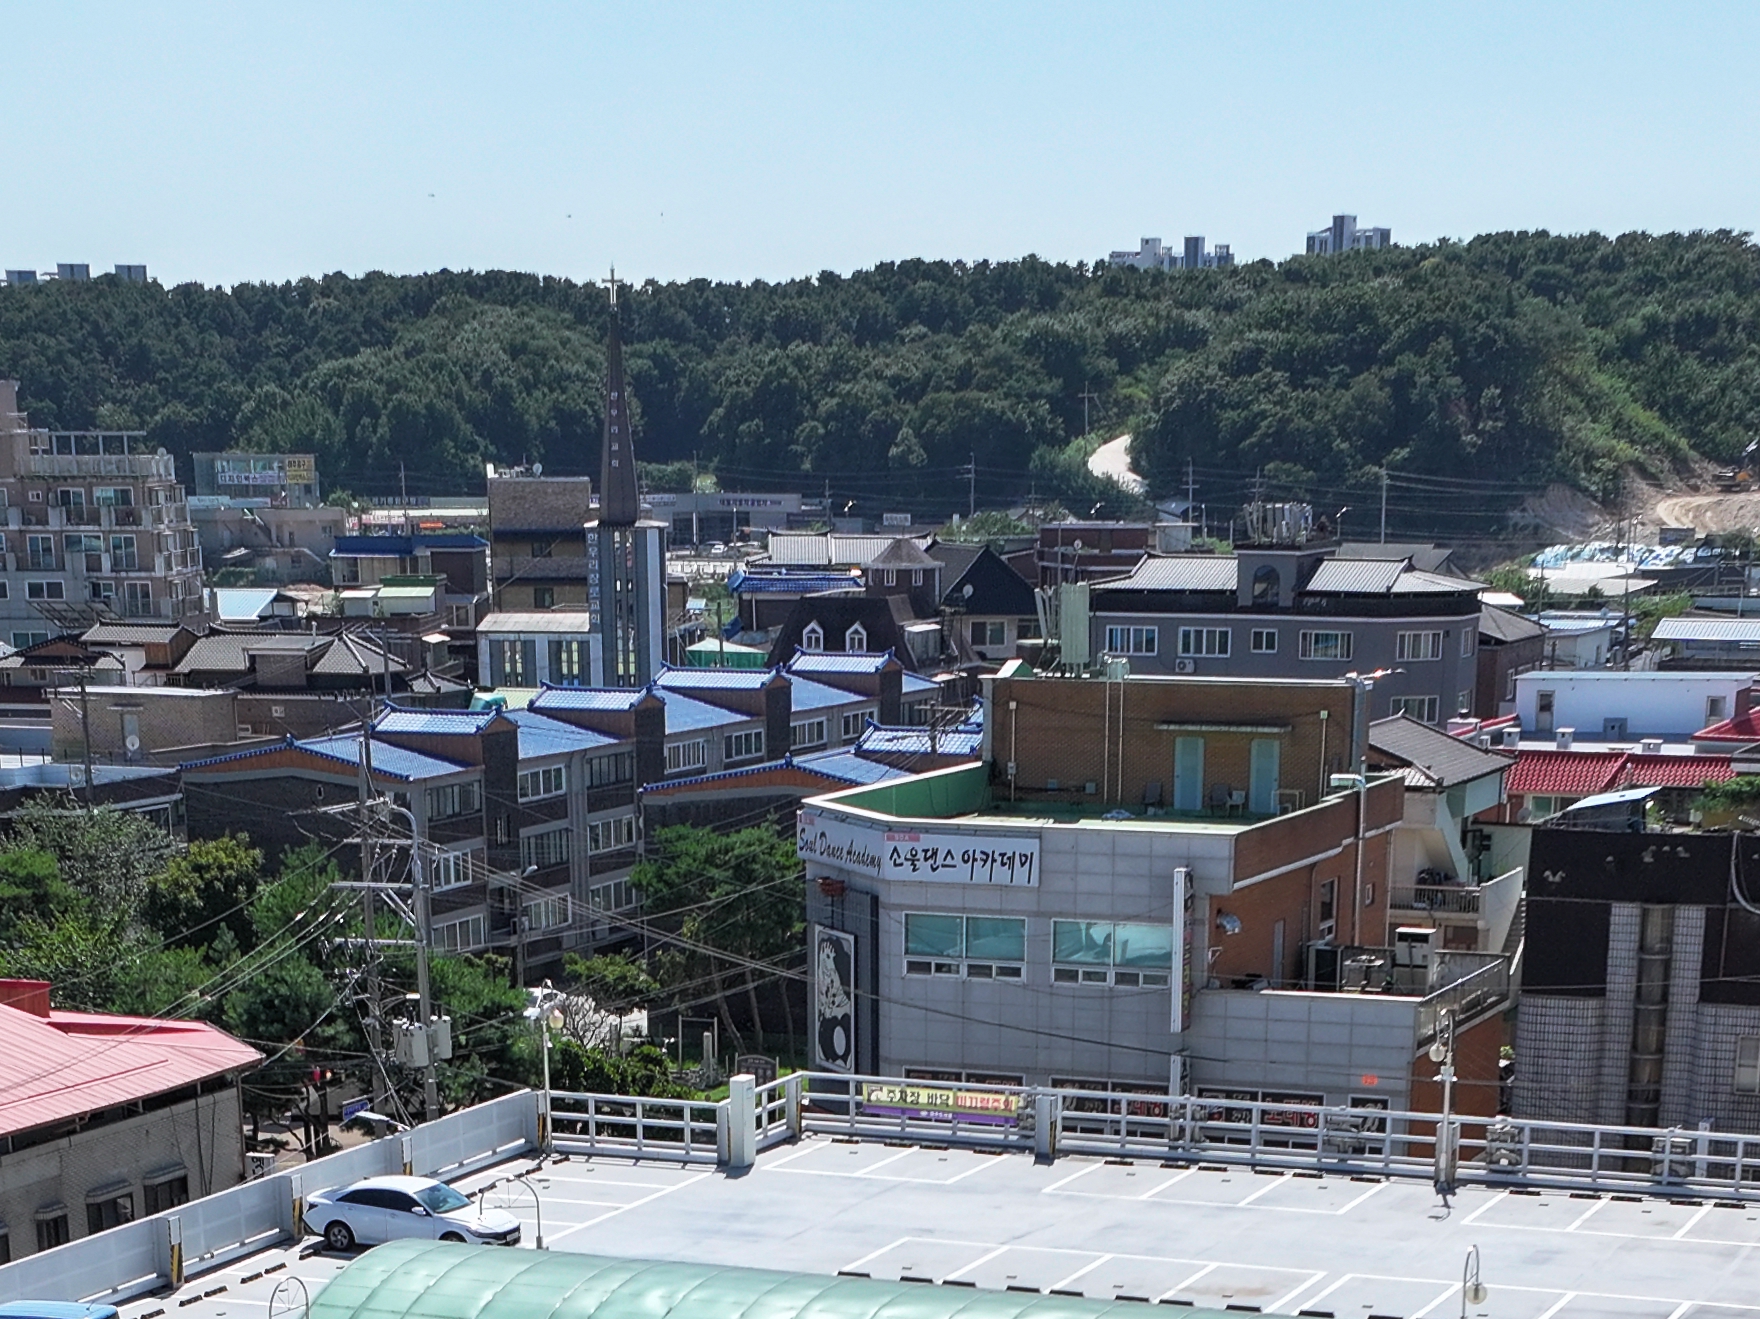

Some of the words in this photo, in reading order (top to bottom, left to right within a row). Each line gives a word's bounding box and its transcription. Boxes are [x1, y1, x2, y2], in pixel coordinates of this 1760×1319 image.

[819, 831, 844, 862] Dance
[845, 839, 883, 875] Academy
[961, 848, 1035, 885] 아카데미
[886, 1086, 921, 1106] 주차장
